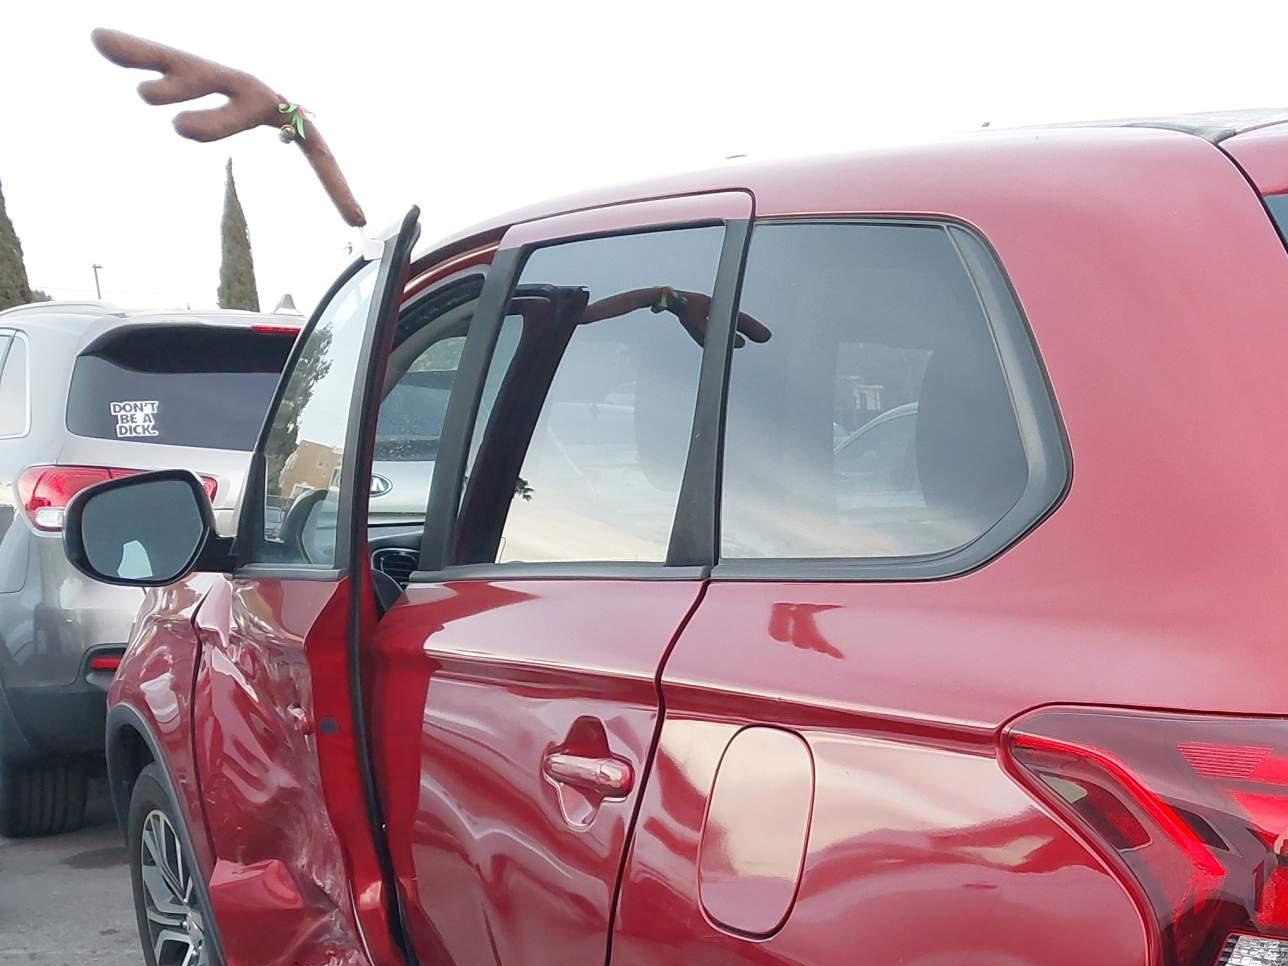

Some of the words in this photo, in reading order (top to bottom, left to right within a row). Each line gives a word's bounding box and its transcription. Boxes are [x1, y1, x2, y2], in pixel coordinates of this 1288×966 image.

[112, 402, 157, 414] DON'T
[120, 414, 138, 424] BE
[143, 413, 153, 424] A
[118, 424, 158, 436] DICK.
